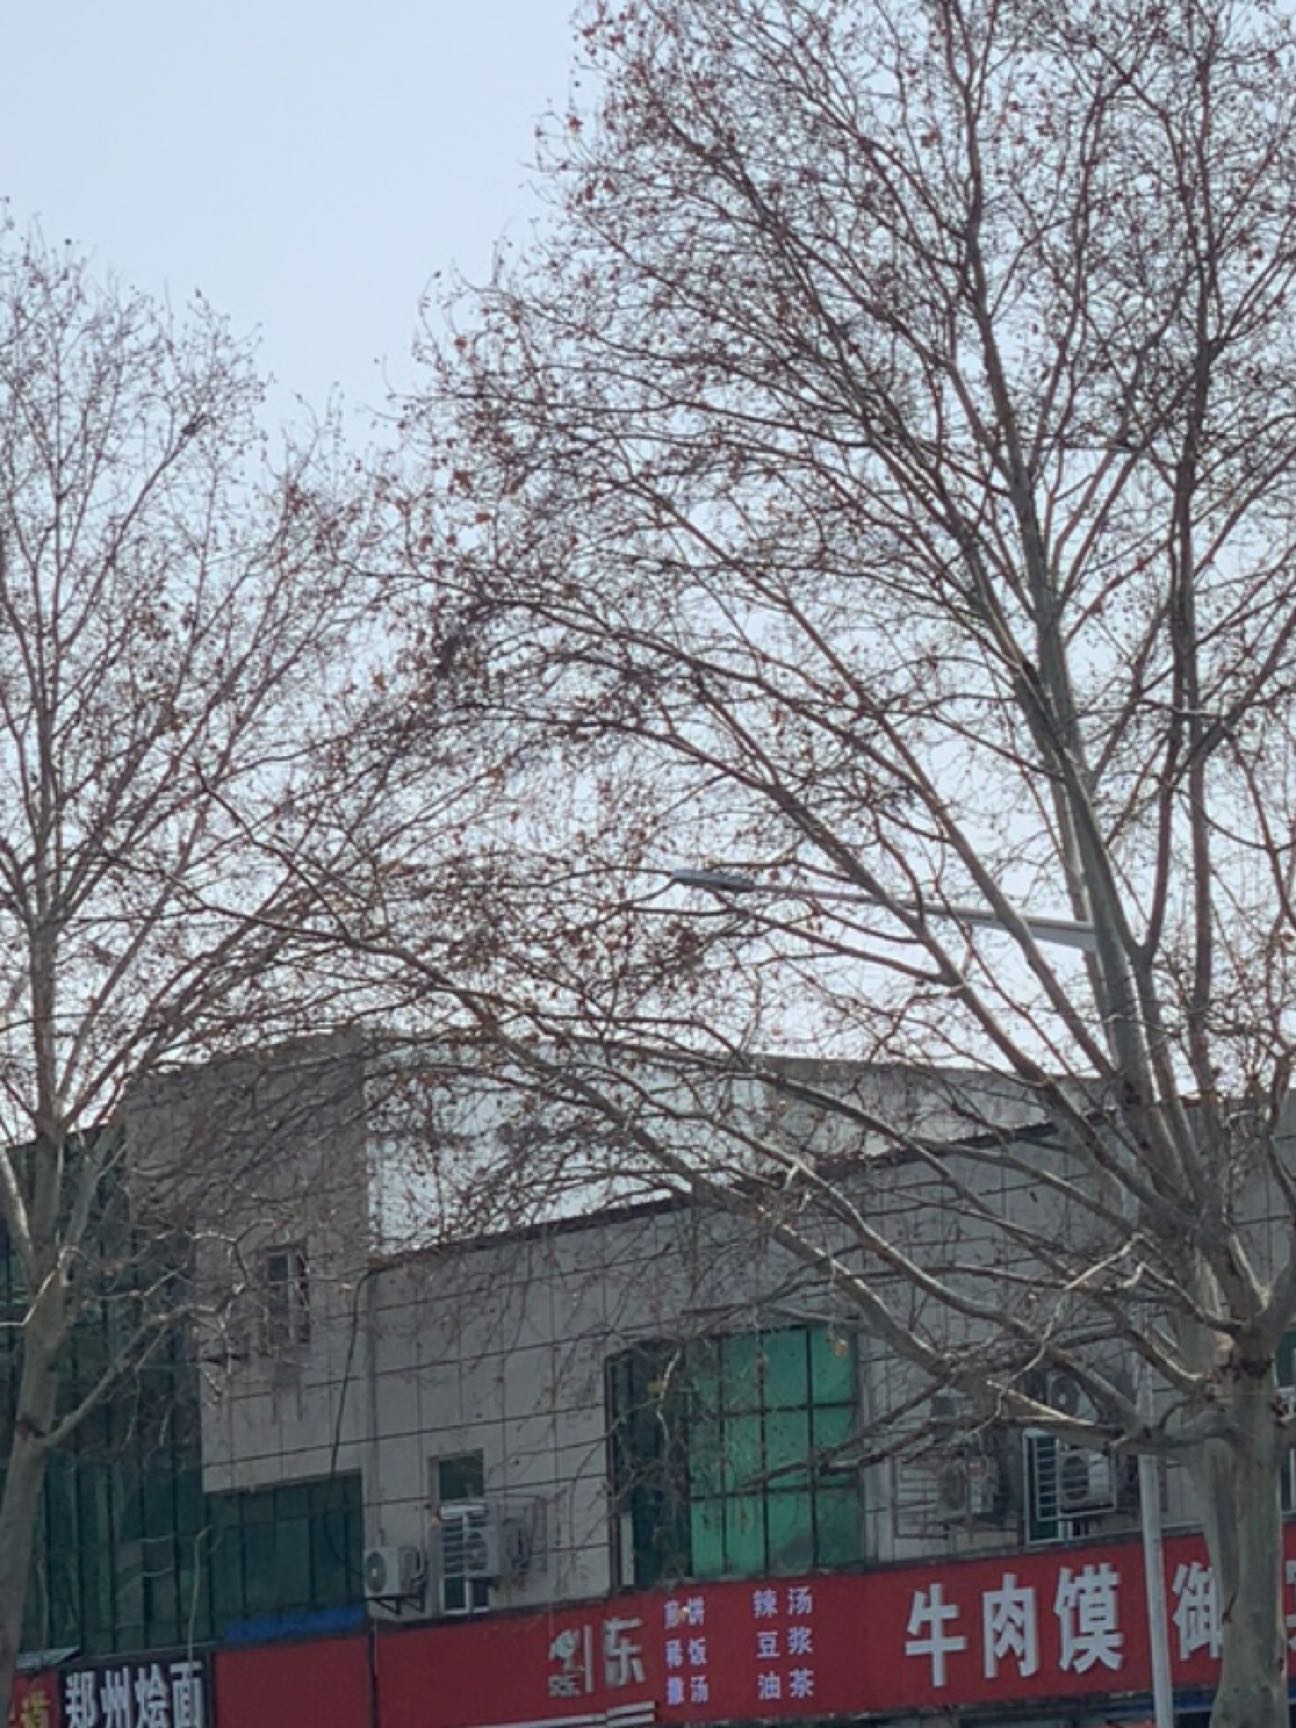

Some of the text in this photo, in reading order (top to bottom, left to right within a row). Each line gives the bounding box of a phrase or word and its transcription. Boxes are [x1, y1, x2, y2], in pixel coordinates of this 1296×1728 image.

[904, 1561, 1126, 1688] 牛肉馍
[756, 1625, 815, 1660] 豆浆
[758, 1667, 816, 1702] 油茶
